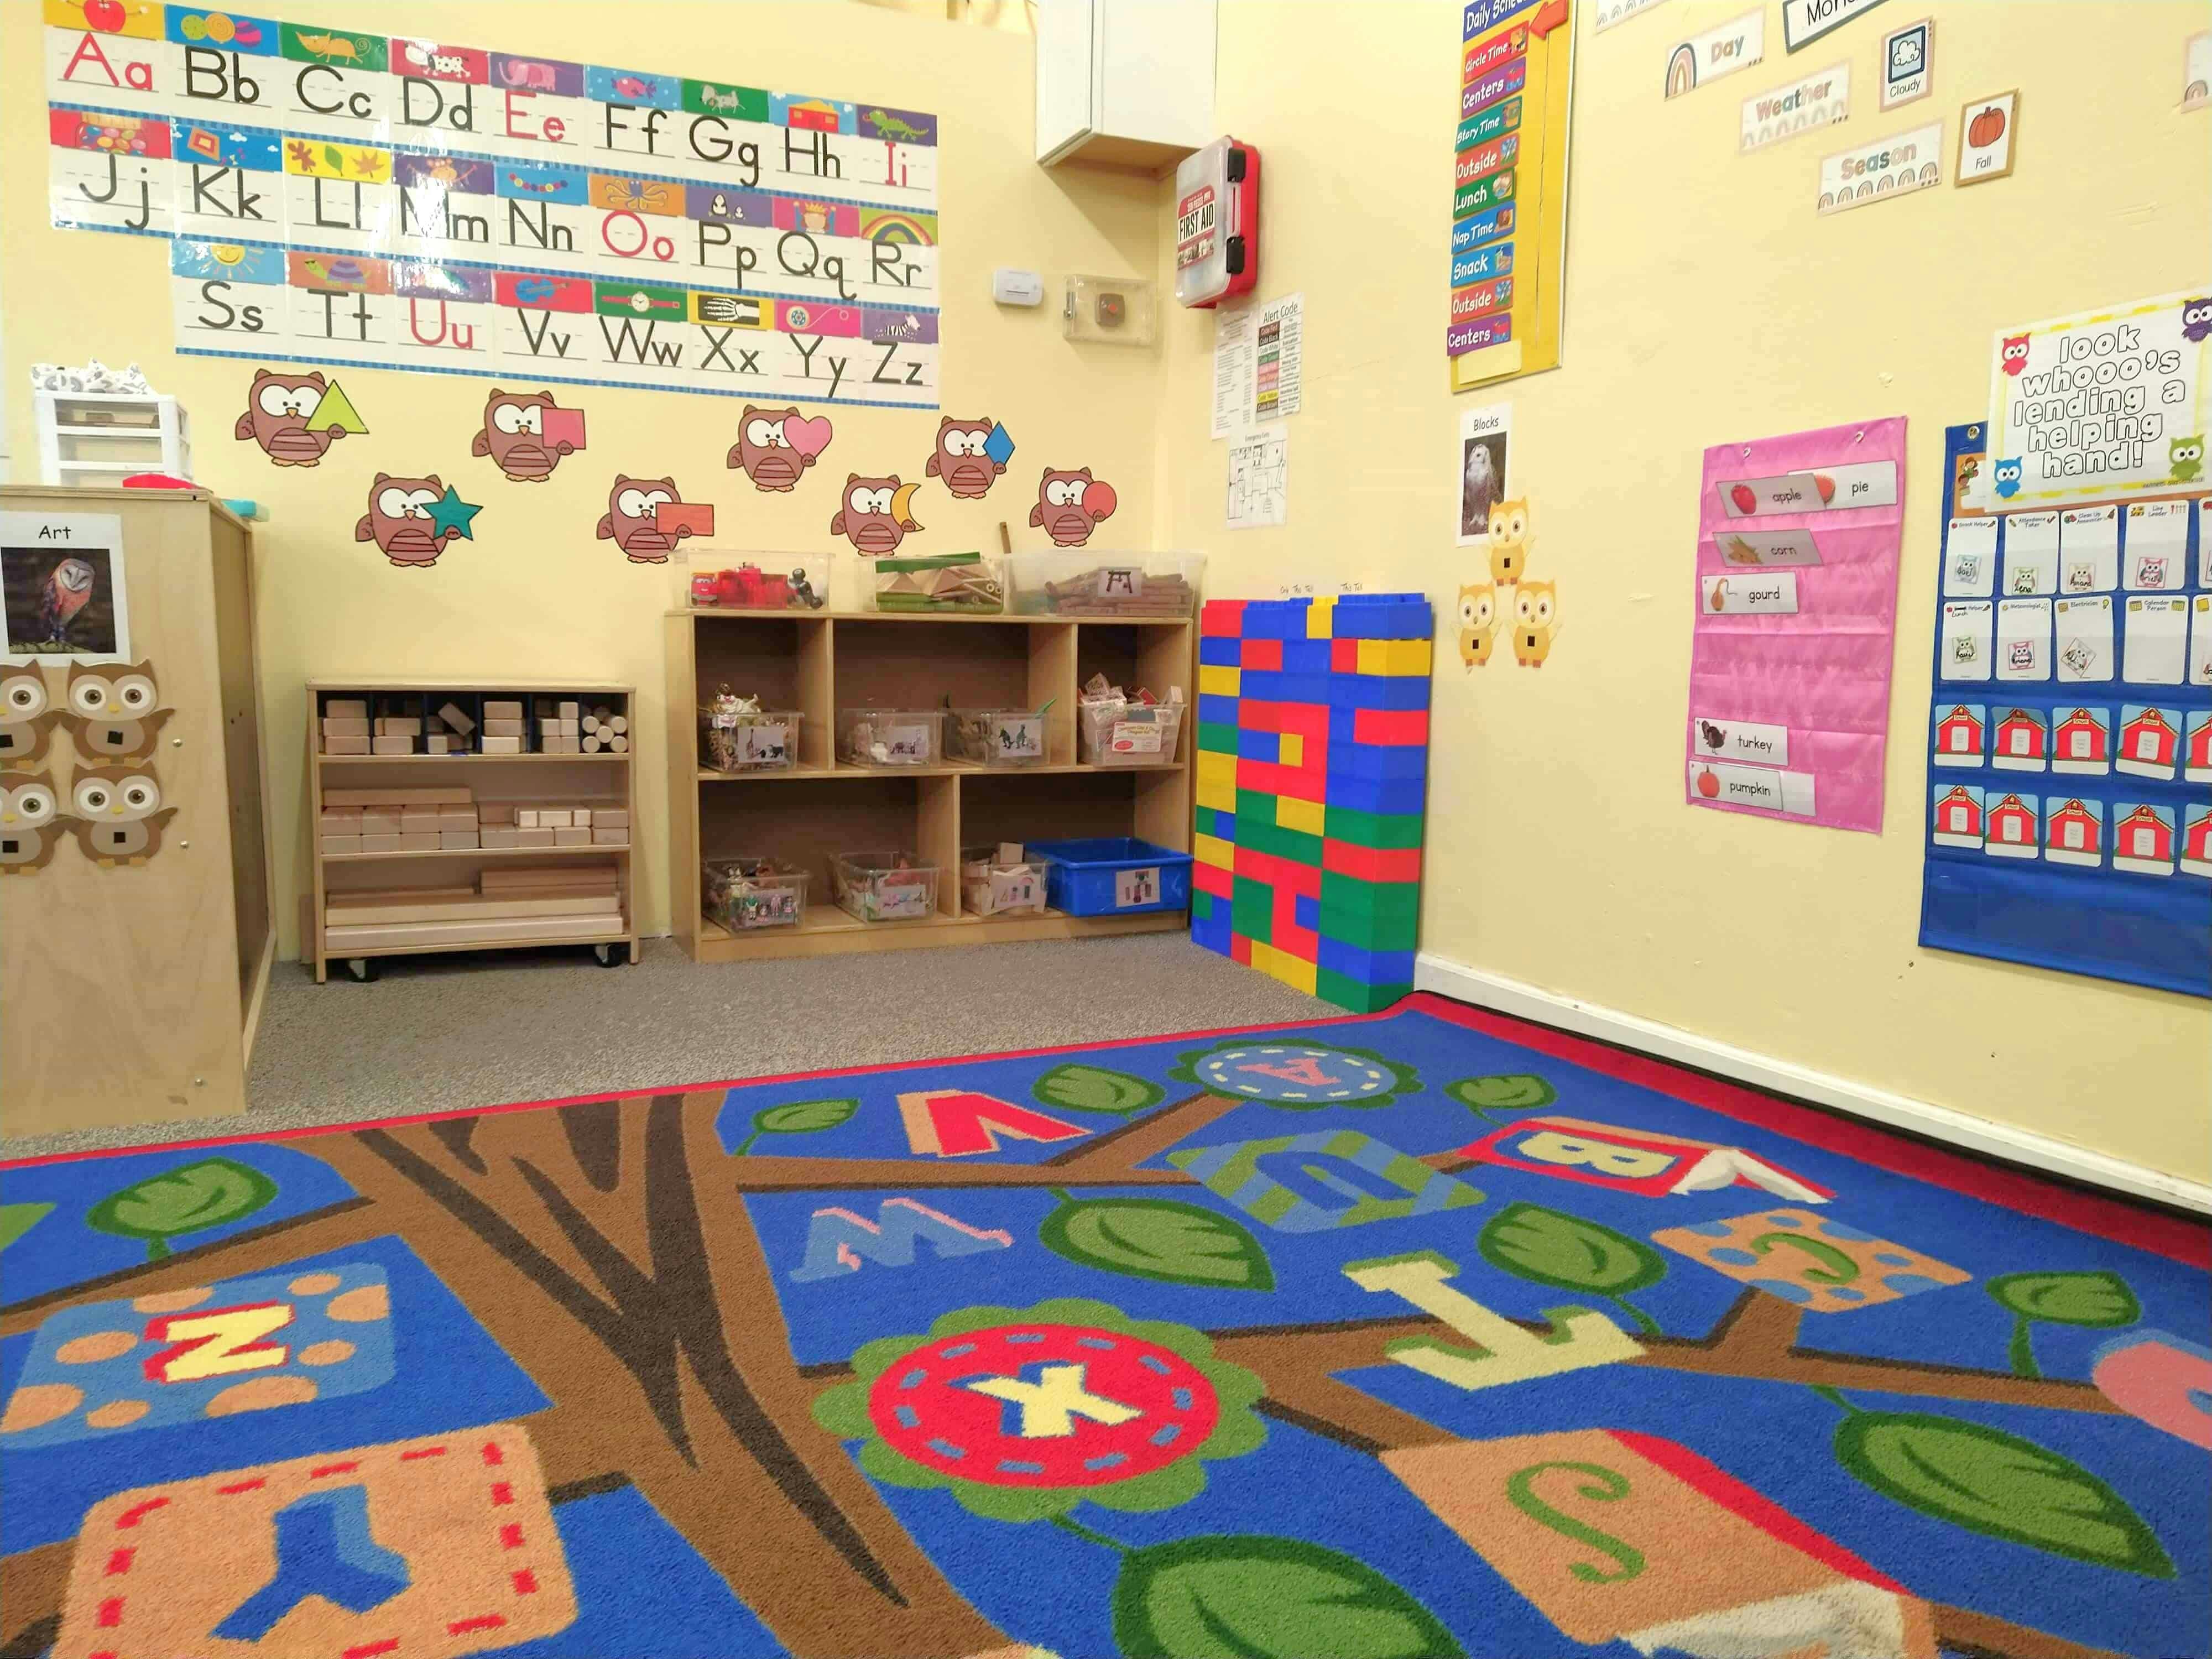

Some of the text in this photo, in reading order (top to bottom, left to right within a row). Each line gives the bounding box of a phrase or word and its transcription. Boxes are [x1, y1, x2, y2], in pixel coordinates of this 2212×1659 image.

[1467, 2, 1490, 32] Daily
[1465, 41, 1508, 72] Circle Time
[1710, 33, 1745, 65] Day
[1462, 79, 1504, 110] Centers
[1756, 78, 1832, 123] Weather
[1890, 78, 1921, 98] Cloudy
[64, 32, 907, 187] Aa Bb Cc Dd Ee Ff Gg Hh Ii
[1457, 117, 1500, 143] Story Time
[1456, 151, 1497, 179] Outside
[1840, 142, 1917, 180] Season
[1975, 155, 1991, 170] Fall
[1455, 185, 1488, 211] Lunch
[79, 153, 922, 300] Jj Kk Ll Mm Nn Oo Pp Qq Rr
[1180, 210, 1199, 241] FIRST
[1201, 203, 1213, 231] AID
[1453, 222, 1494, 248] Nap Time
[1454, 253, 1489, 280] Snack
[1264, 301, 1298, 324] Alert Code
[1452, 291, 1491, 314] Outside
[198, 280, 924, 398] Ss Tt Uu Vv Ww Xx Yy Zz
[1448, 327, 1490, 347] Centers
[2059, 324, 2141, 364] look
[2022, 349, 2181, 398] whooo's
[2013, 379, 2185, 427] lending a
[1474, 416, 1499, 431] Blocks
[2028, 413, 2163, 453] helping
[2042, 440, 2145, 479] hand!
[1772, 481, 1869, 505] apple pie
[39, 525, 71, 539] Art
[1771, 545, 1796, 556] corn
[1749, 587, 1780, 603] gourd
[1738, 735, 1772, 754] turkey
[1730, 781, 1771, 797] pumpkin
[1237, 1057, 1342, 1088] A
[896, 1089, 1093, 1157] V
[1517, 1130, 1682, 1177] B
[1254, 1149, 1417, 1210] U
[789, 1197, 1014, 1283] W
[1750, 1233, 1860, 1285] C
[1340, 1250, 1647, 1391] T
[947, 1359, 1145, 1439] X
[1506, 1460, 1647, 1584] S
[208, 1483, 413, 1644] Y
